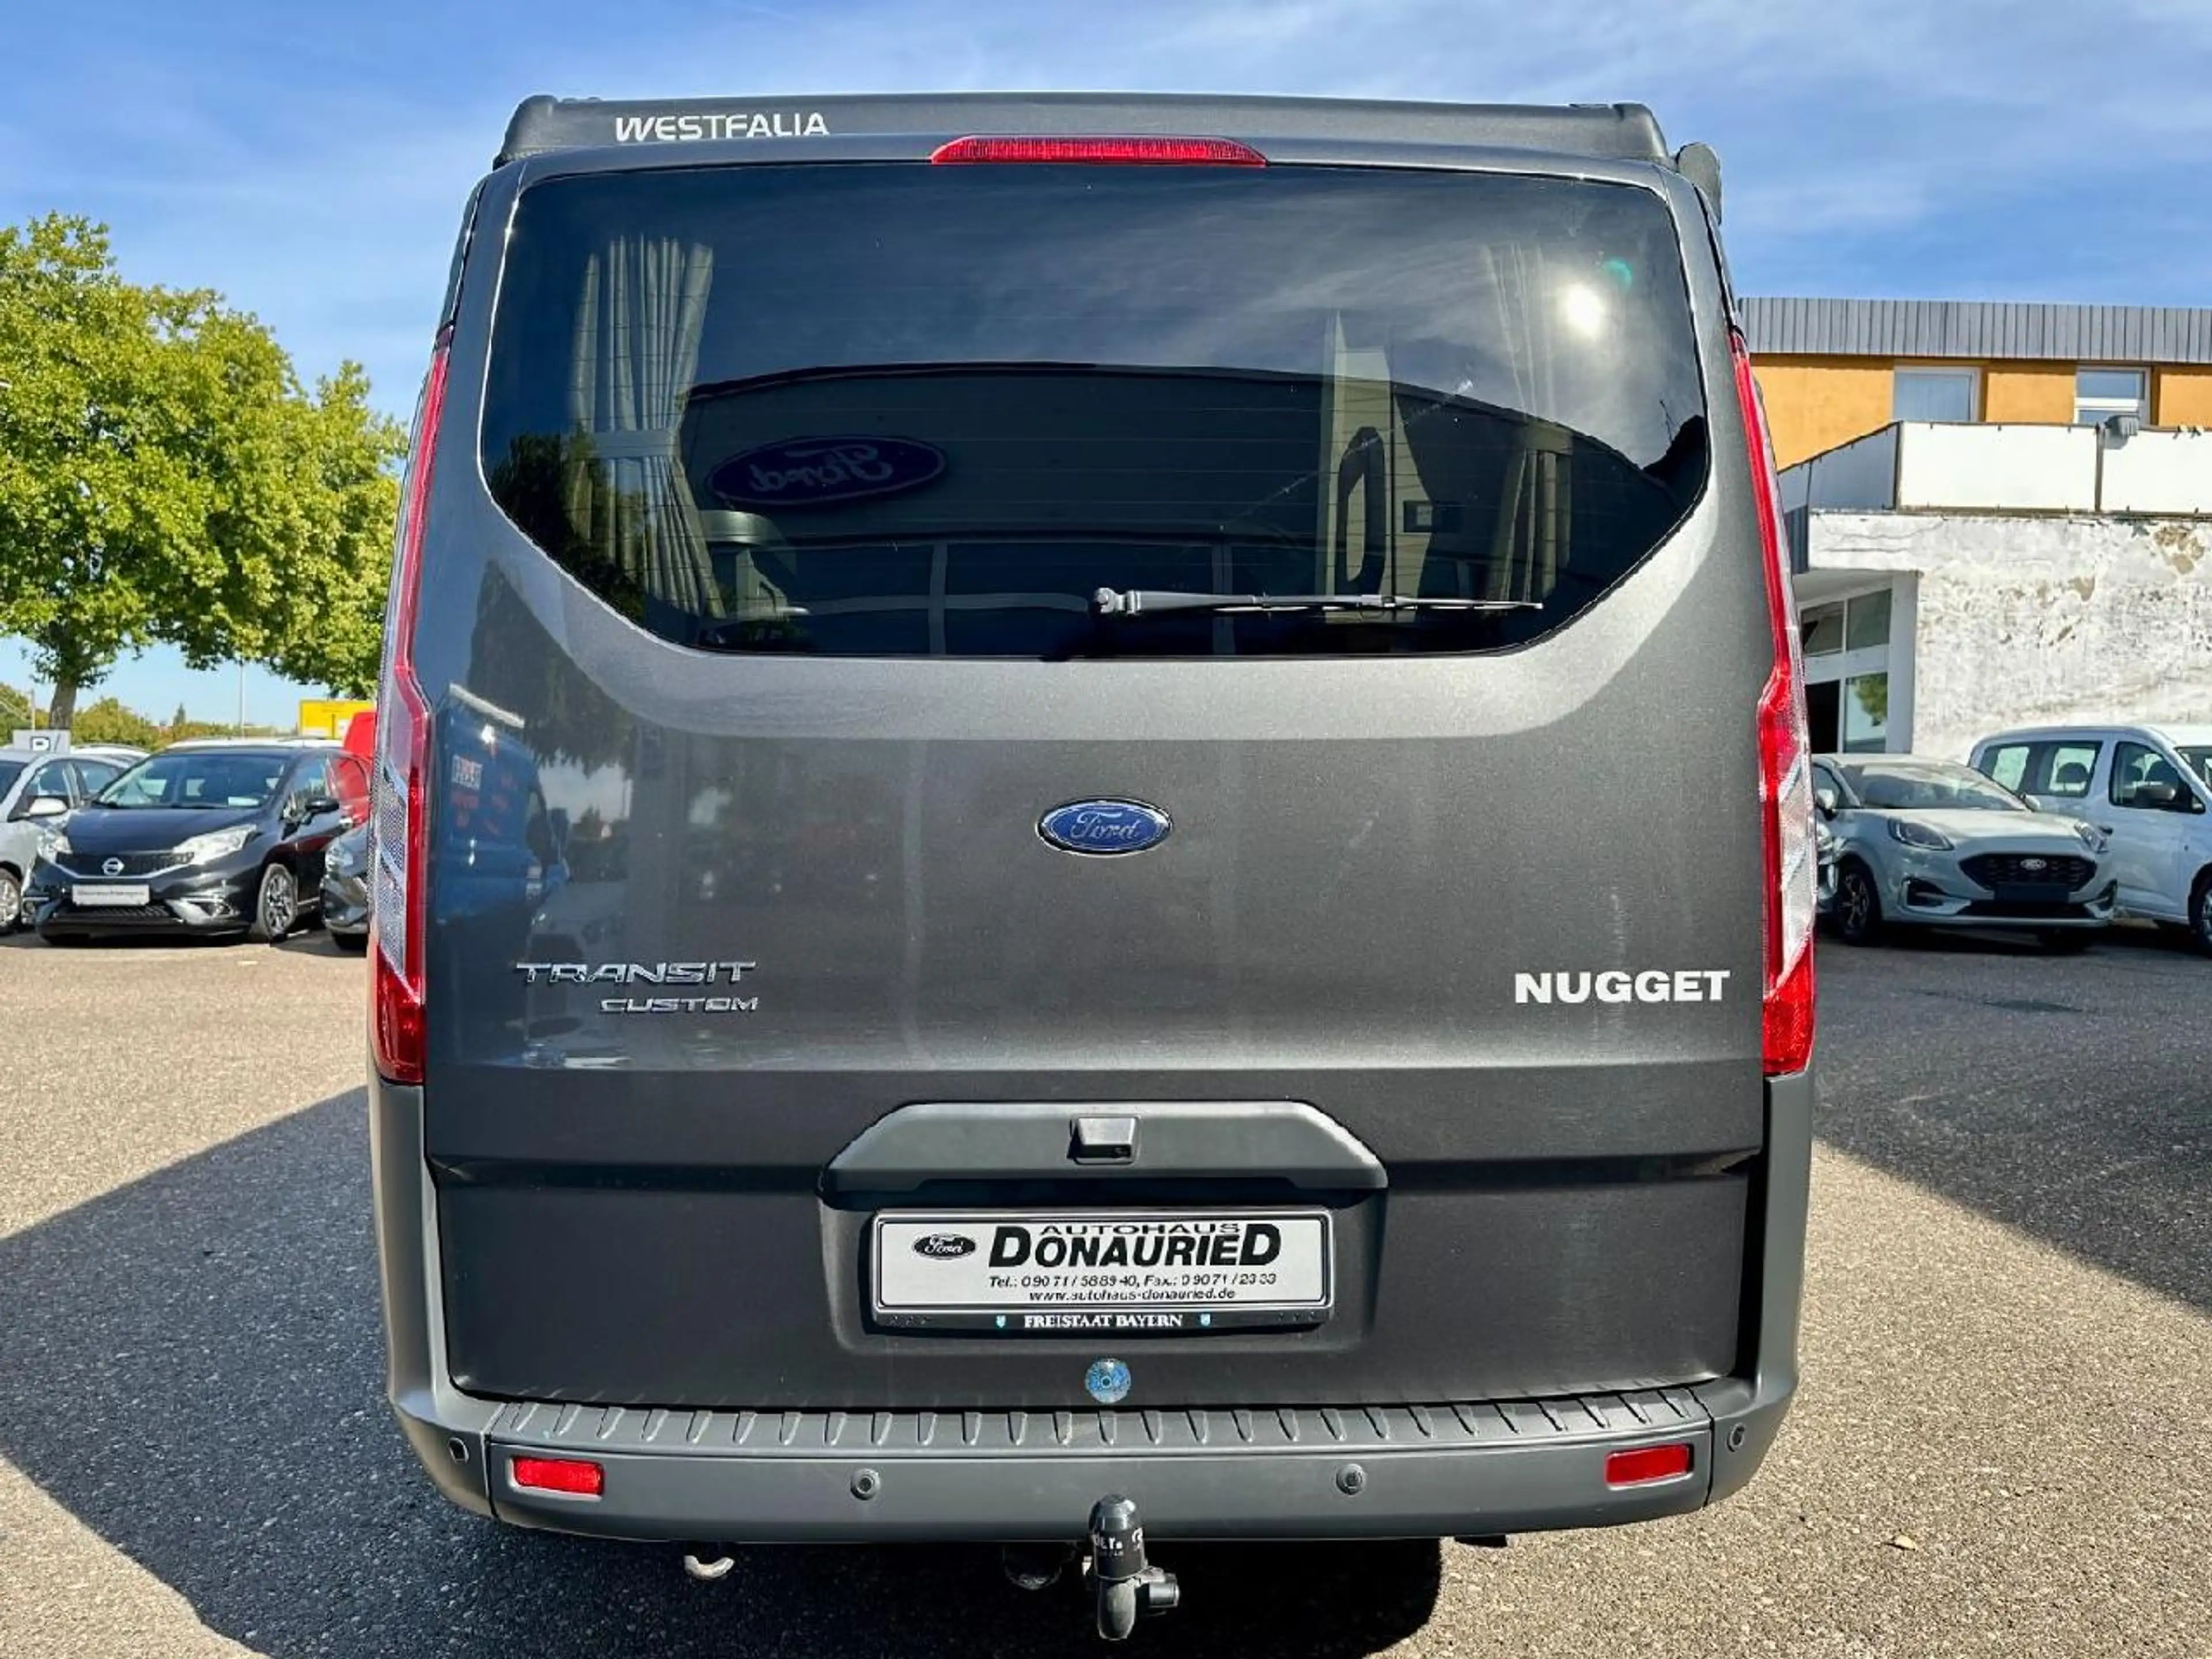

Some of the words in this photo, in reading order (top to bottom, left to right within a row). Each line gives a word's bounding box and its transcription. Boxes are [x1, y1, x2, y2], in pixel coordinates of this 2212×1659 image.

[615, 113, 830, 142] WESTFALIA
[1070, 811, 1141, 839] Ford
[516, 961, 757, 984] TRANSIT
[1514, 970, 1730, 1003] NUGGET
[600, 997, 759, 1012] CUSTOM
[1040, 1224, 1240, 1235] AUTOHAUS
[1029, 1288, 1236, 1301] www.autohaus-donauried.de
[1024, 1314, 1113, 1328] FREISTAAT
[1116, 1314, 1183, 1328] BAYERN
